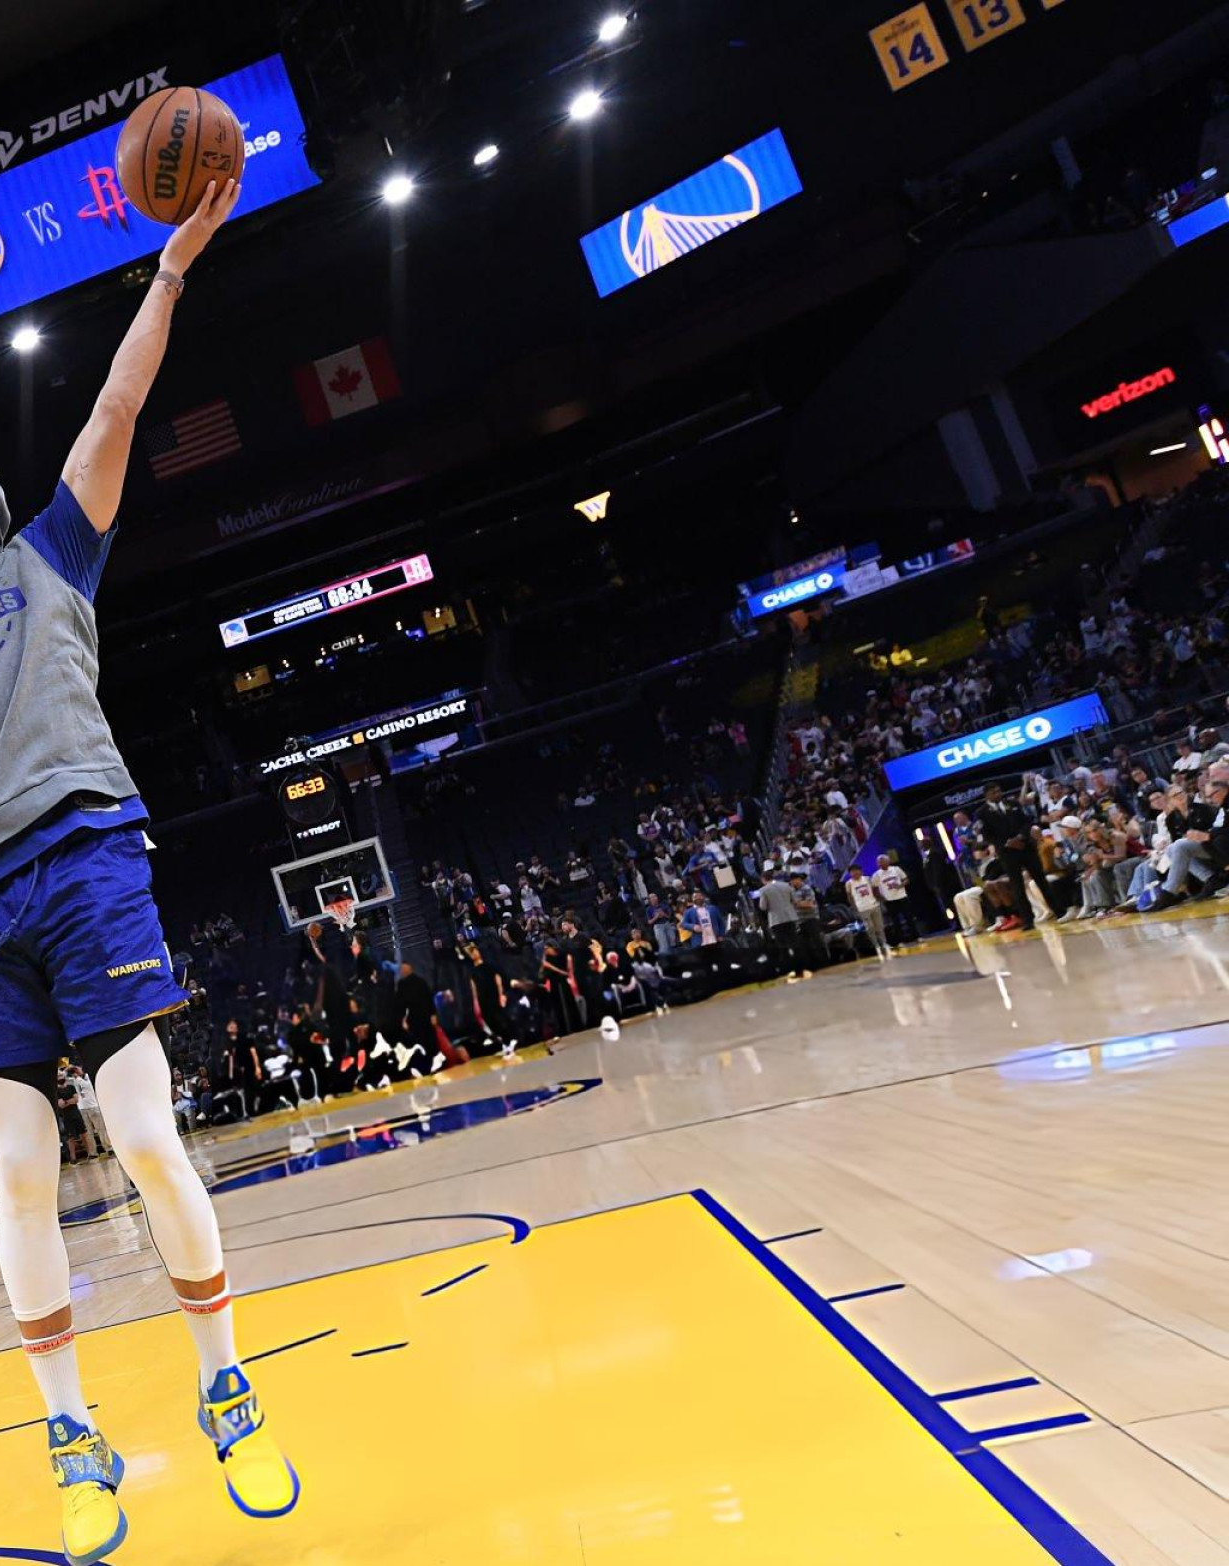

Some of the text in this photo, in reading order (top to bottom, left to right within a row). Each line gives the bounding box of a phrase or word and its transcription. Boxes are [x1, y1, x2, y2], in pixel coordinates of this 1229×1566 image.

[963, 0, 1010, 38] 13
[890, 32, 935, 78] 14
[29, 66, 169, 145] DENVIX
[154, 107, 191, 199] Wilson
[22, 202, 62, 246] VS
[1081, 367, 1175, 418] verizon
[216, 503, 281, 537] Modelo
[762, 580, 817, 609] CHASE
[306, 737, 352, 760] CREEK
[366, 717, 417, 741] CASINO
[417, 700, 468, 726] RESORT
[937, 726, 1026, 769] CHASE
[286, 776, 326, 800] 66:33
[106, 958, 162, 979] WARRIORS
